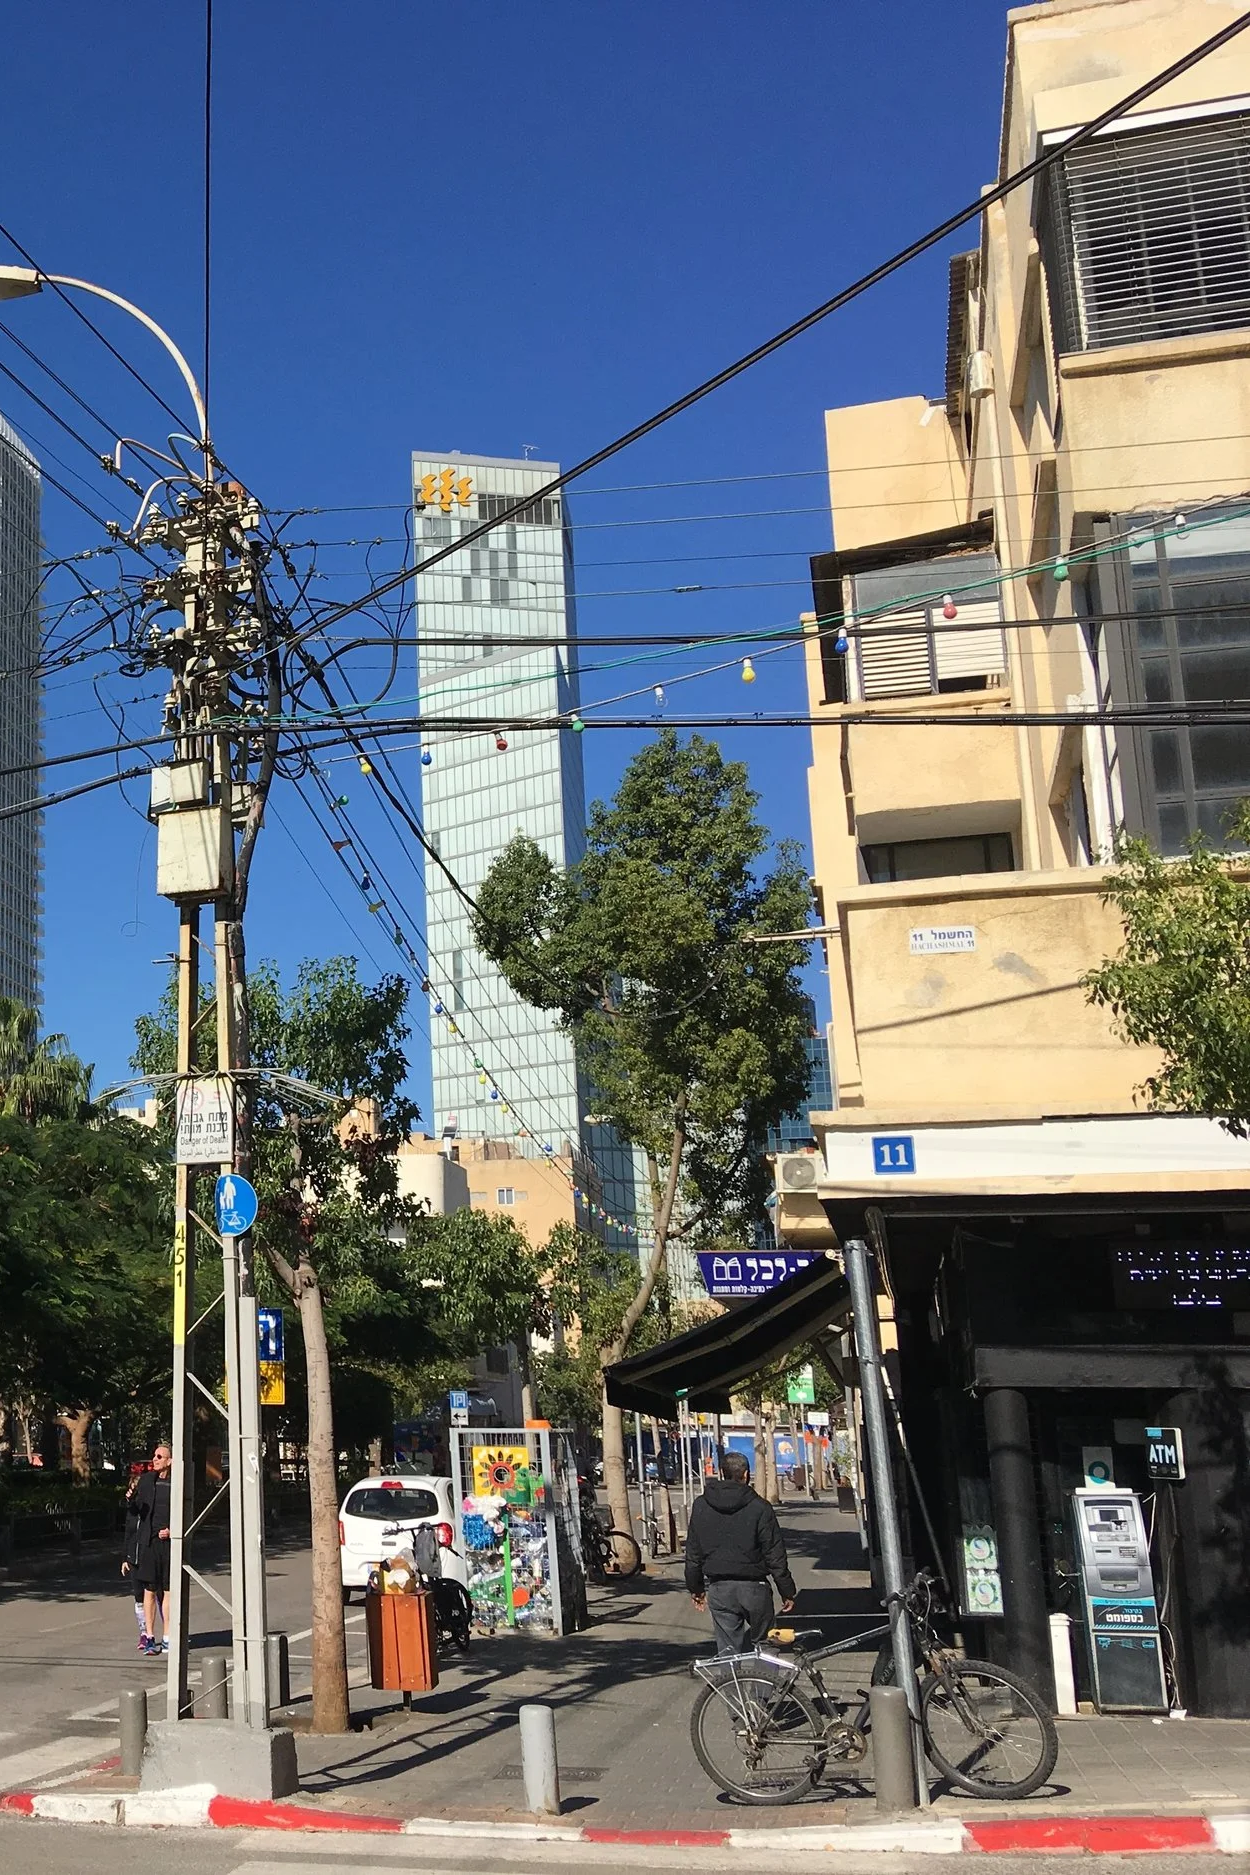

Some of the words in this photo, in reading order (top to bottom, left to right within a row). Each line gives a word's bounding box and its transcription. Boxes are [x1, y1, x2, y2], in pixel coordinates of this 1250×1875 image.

[912, 933, 923, 941] 11
[931, 929, 973, 940] החשמל
[911, 940, 964, 950] HACHASHMAL
[181, 1113, 204, 1123] גבה!
[208, 1112, 227, 1122] מתח
[206, 1122, 228, 1133] סכנת
[180, 1136, 201, 1146] Danger
[202, 1135, 208, 1144] of
[210, 1135, 229, 1143] Death!
[880, 1144, 909, 1166] 11
[174, 1224, 185, 1288] 451
[1149, 1443, 1176, 1464] ATM
[1105, 1613, 1144, 1623] כספומט
